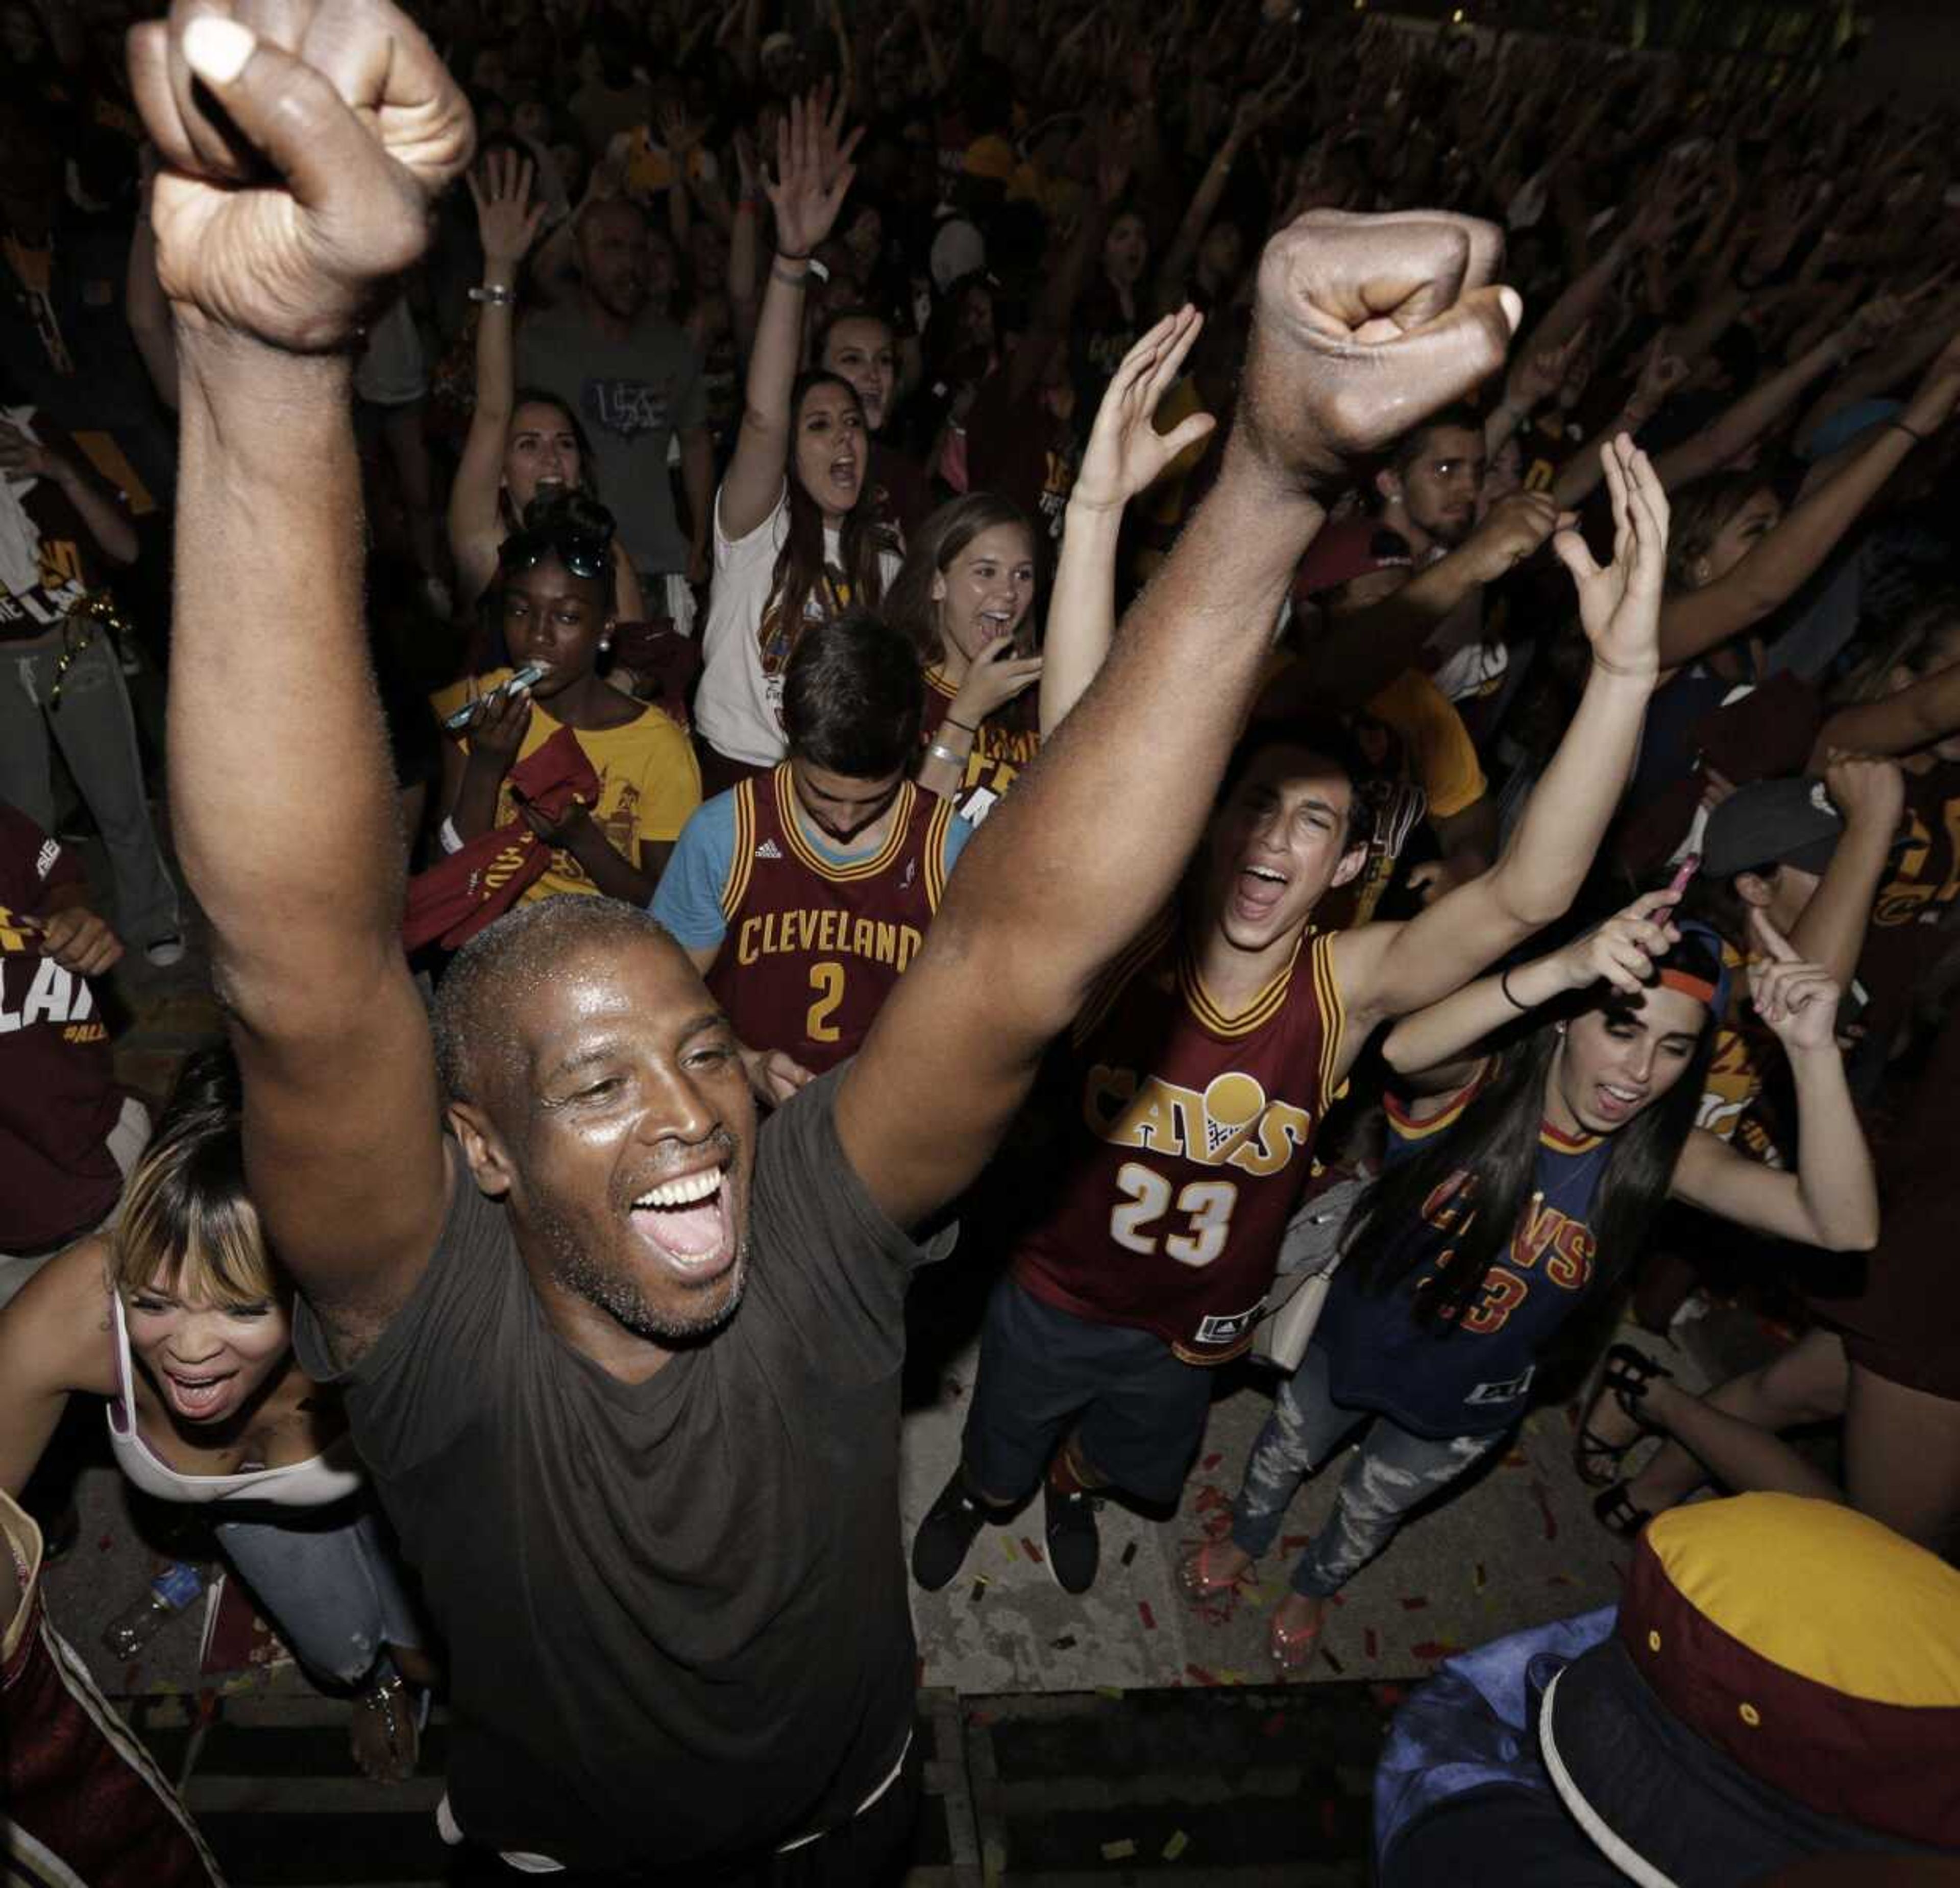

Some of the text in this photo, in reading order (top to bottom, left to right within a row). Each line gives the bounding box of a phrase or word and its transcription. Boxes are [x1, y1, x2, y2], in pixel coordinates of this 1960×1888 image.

[737, 909, 924, 973] CLEVELAND
[806, 961, 846, 1044] 2
[1081, 1063, 1311, 1176] CAVS
[1109, 1161, 1239, 1268] 23
